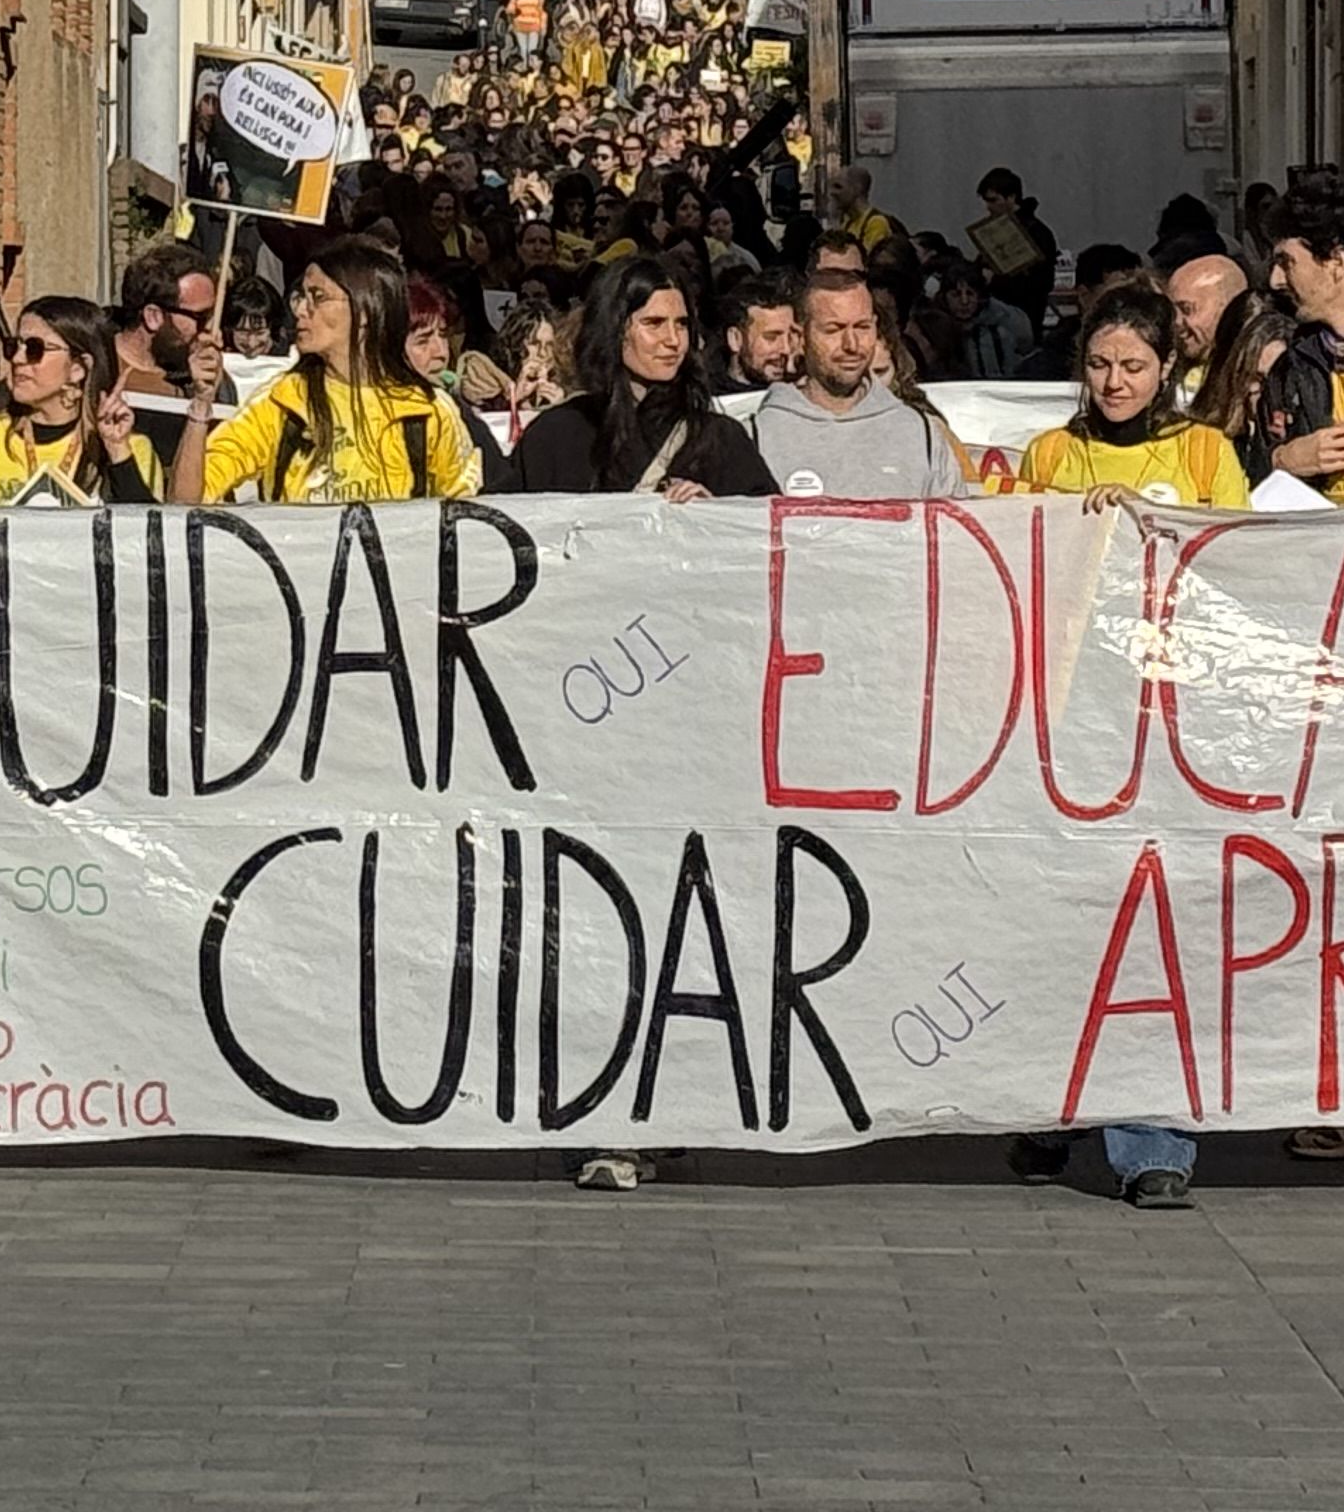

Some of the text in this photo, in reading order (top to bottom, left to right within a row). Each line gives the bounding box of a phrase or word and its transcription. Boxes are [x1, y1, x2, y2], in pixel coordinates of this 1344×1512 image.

[560, 612, 692, 727] QUI
[198, 823, 873, 1131] CUIDAR
[890, 961, 1007, 1069] QUI
